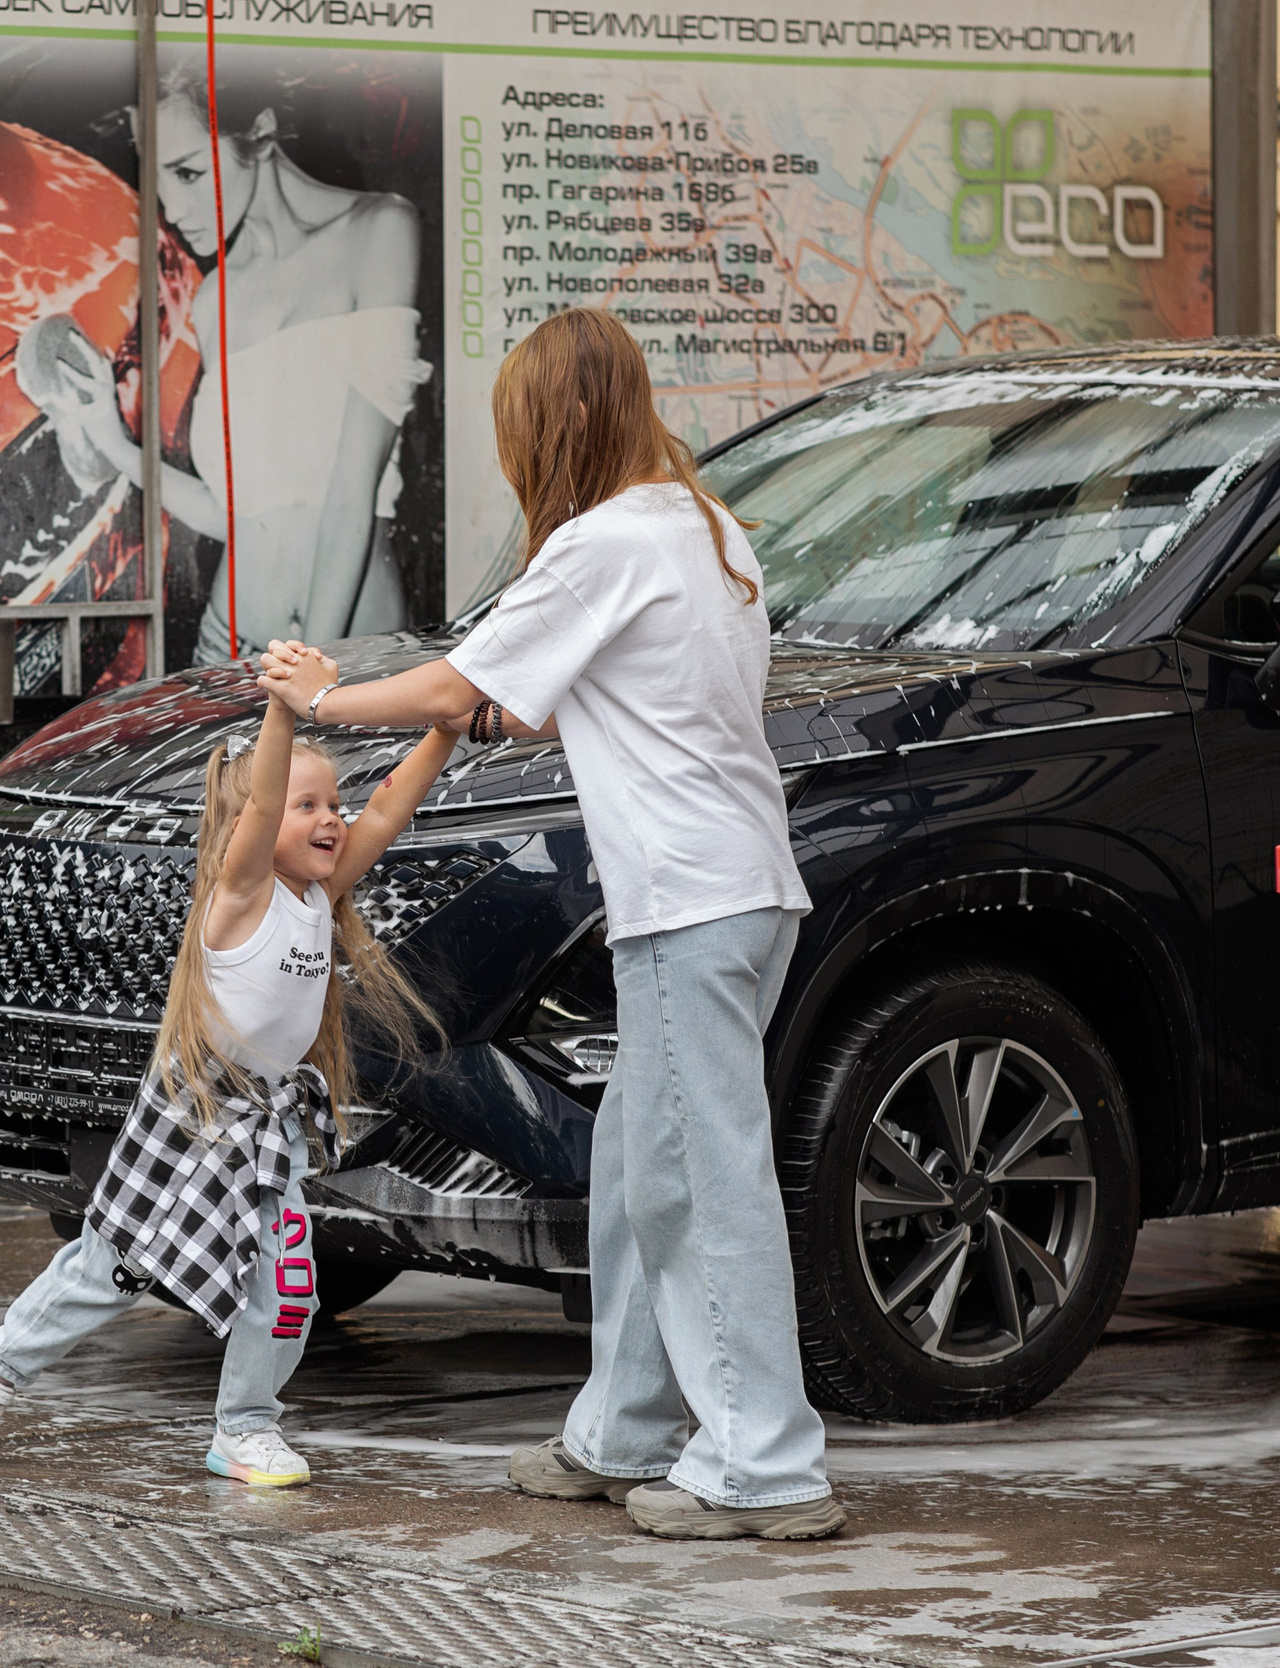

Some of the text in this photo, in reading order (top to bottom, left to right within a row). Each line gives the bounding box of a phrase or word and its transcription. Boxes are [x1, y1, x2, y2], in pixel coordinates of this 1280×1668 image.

[62, 0, 433, 29] САМОБСЛУЖИВАНИЯ
[532, 9, 1136, 56] ПРЕИМУЩЕСТВО БЛАГОДАРЯ ТЕХНОЛОГИИ
[502, 85, 605, 111] Адреса:
[501, 121, 538, 141] ул.
[545, 118, 654, 141] Деловая
[502, 152, 538, 172] ул.
[545, 149, 767, 174] Новикова-Прибоя
[502, 182, 540, 203] пр.
[547, 180, 664, 204] Гагарина
[502, 214, 539, 235] ул.
[546, 210, 652, 235] Рябцева
[1003, 183, 1164, 259] eco
[502, 245, 540, 266] пр.
[549, 241, 718, 265] Молодежный
[502, 276, 539, 297] ул.
[546, 273, 710, 294] Новополевая
[502, 306, 539, 328] ул.
[547, 302, 697, 325] овское
[789, 303, 838, 324] 300
[675, 333, 865, 357] Магистральная
[32, 809, 201, 844] OMOD
[279, 958, 293, 973] in
[290, 947, 312, 962] See
